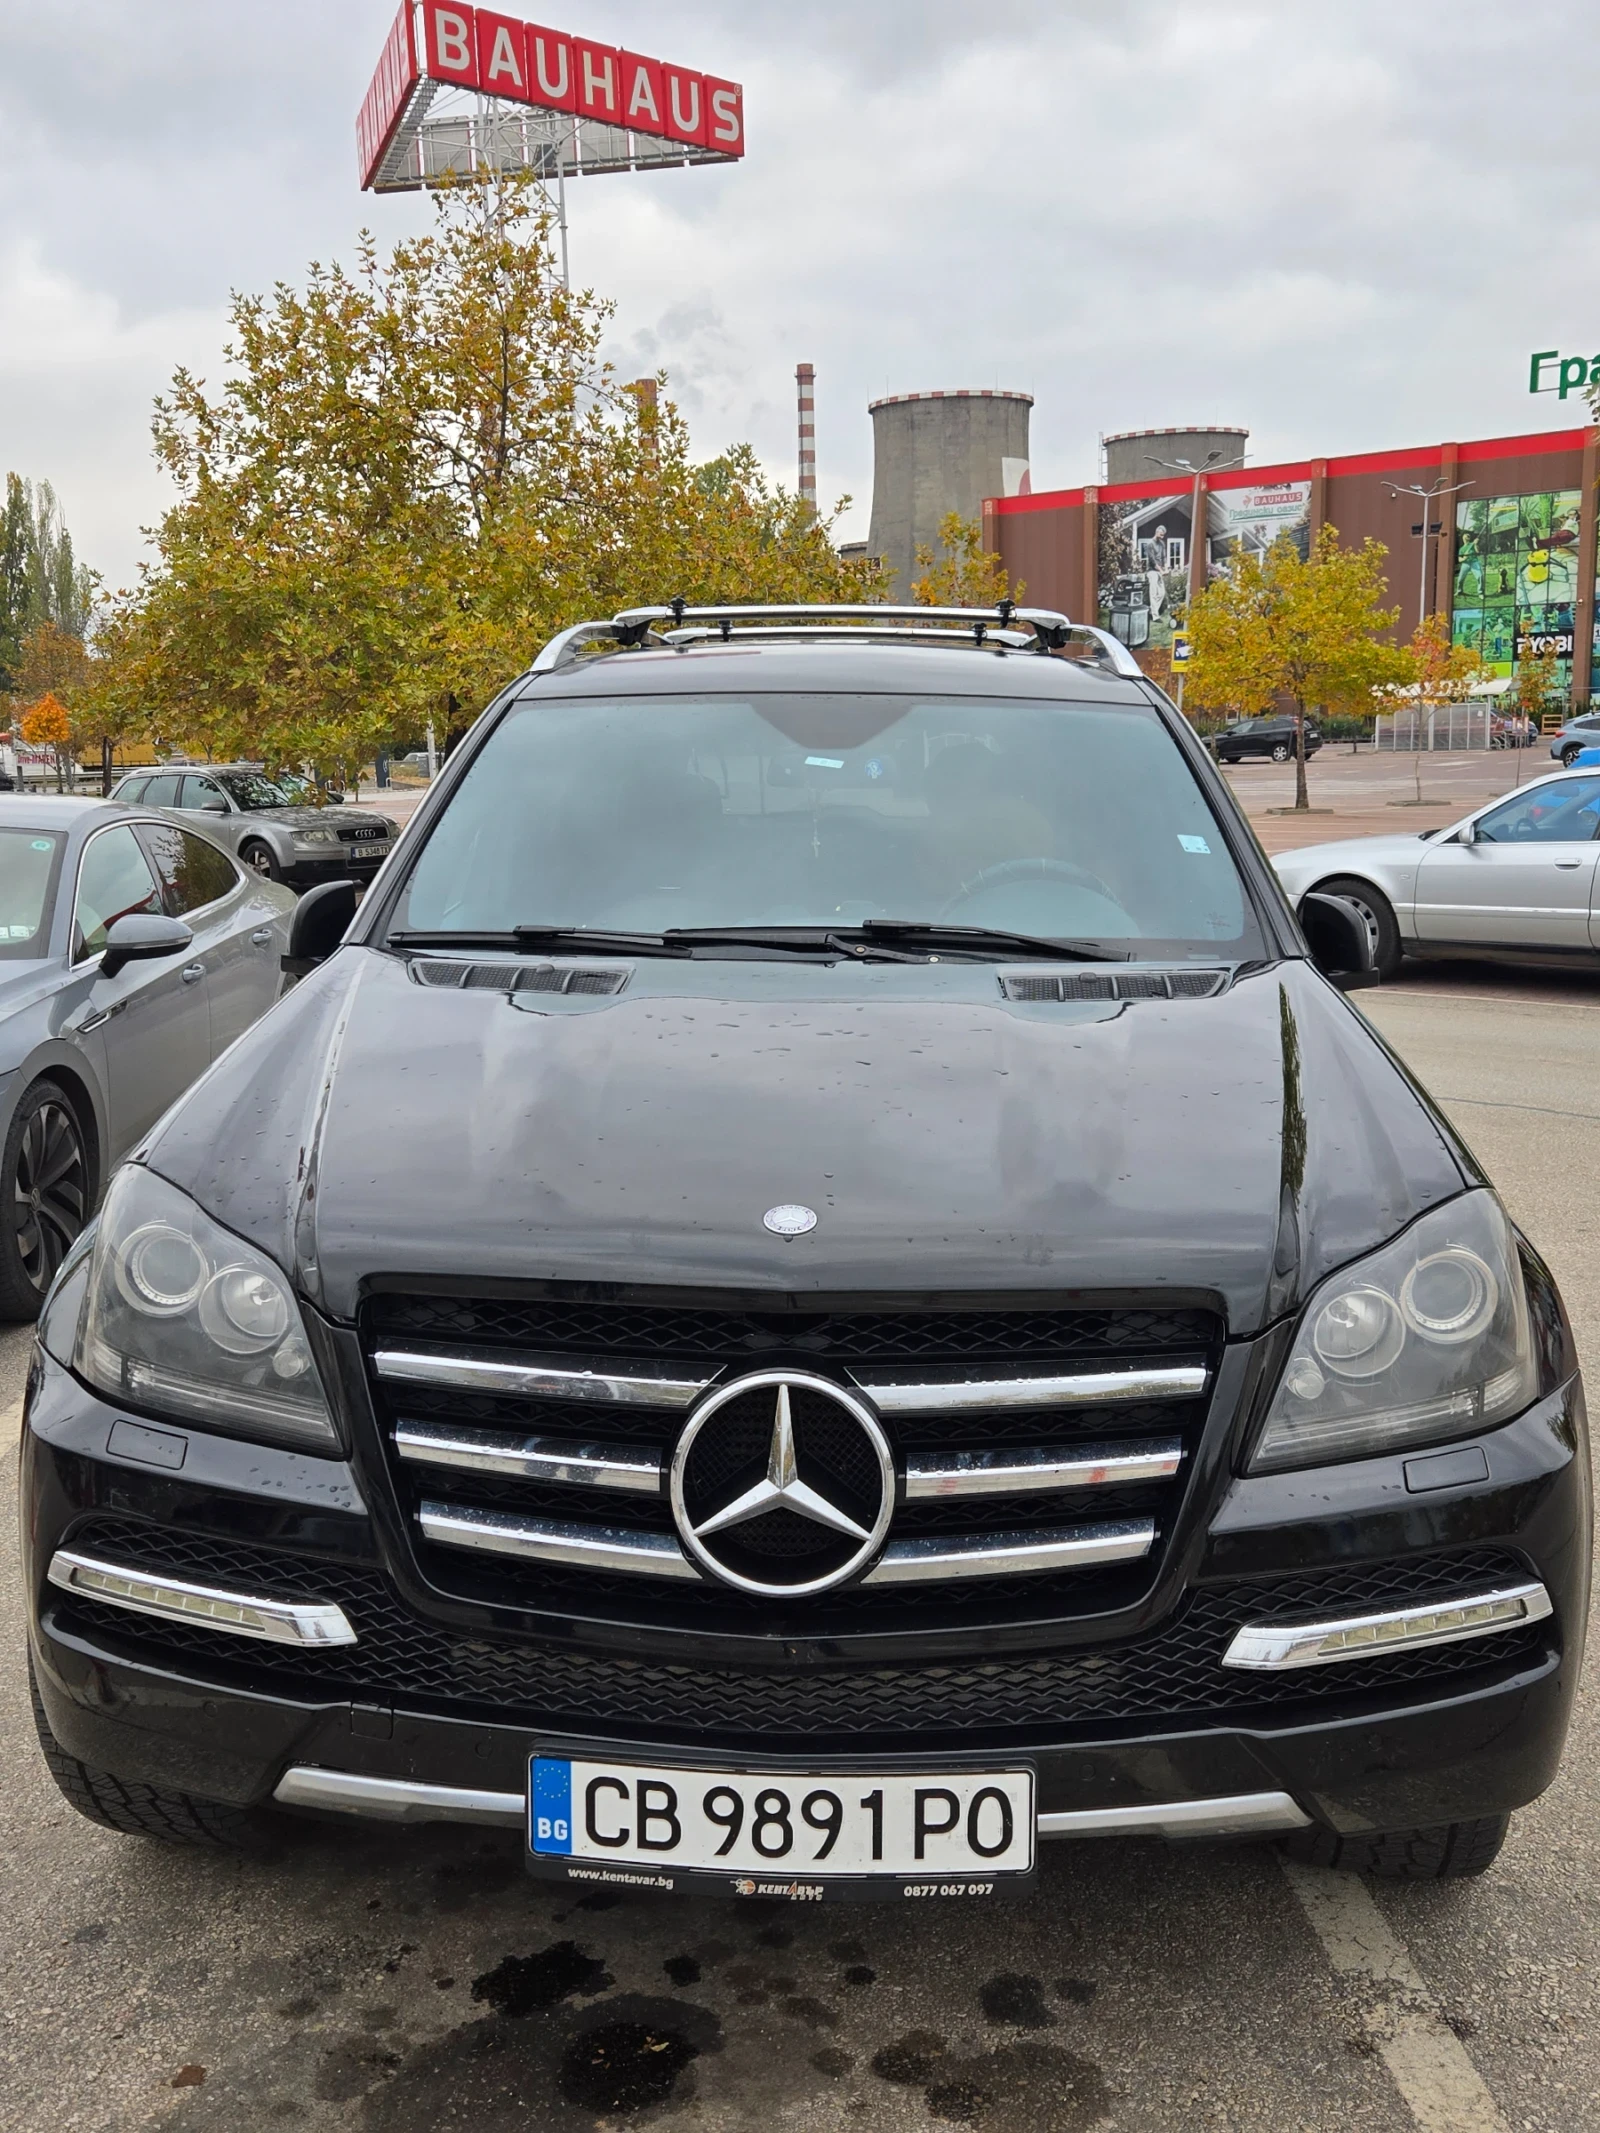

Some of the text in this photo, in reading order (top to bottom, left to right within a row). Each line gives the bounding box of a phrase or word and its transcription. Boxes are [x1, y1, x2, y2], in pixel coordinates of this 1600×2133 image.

[1254, 492, 1302, 505] BAUHAUS
[585, 1776, 682, 1851] CB
[702, 1786, 883, 1860] 9891
[538, 1817, 568, 1841] BG
[568, 1869, 674, 1890] www.kentavar.bg
[903, 1883, 994, 1897] 0877 067 097
